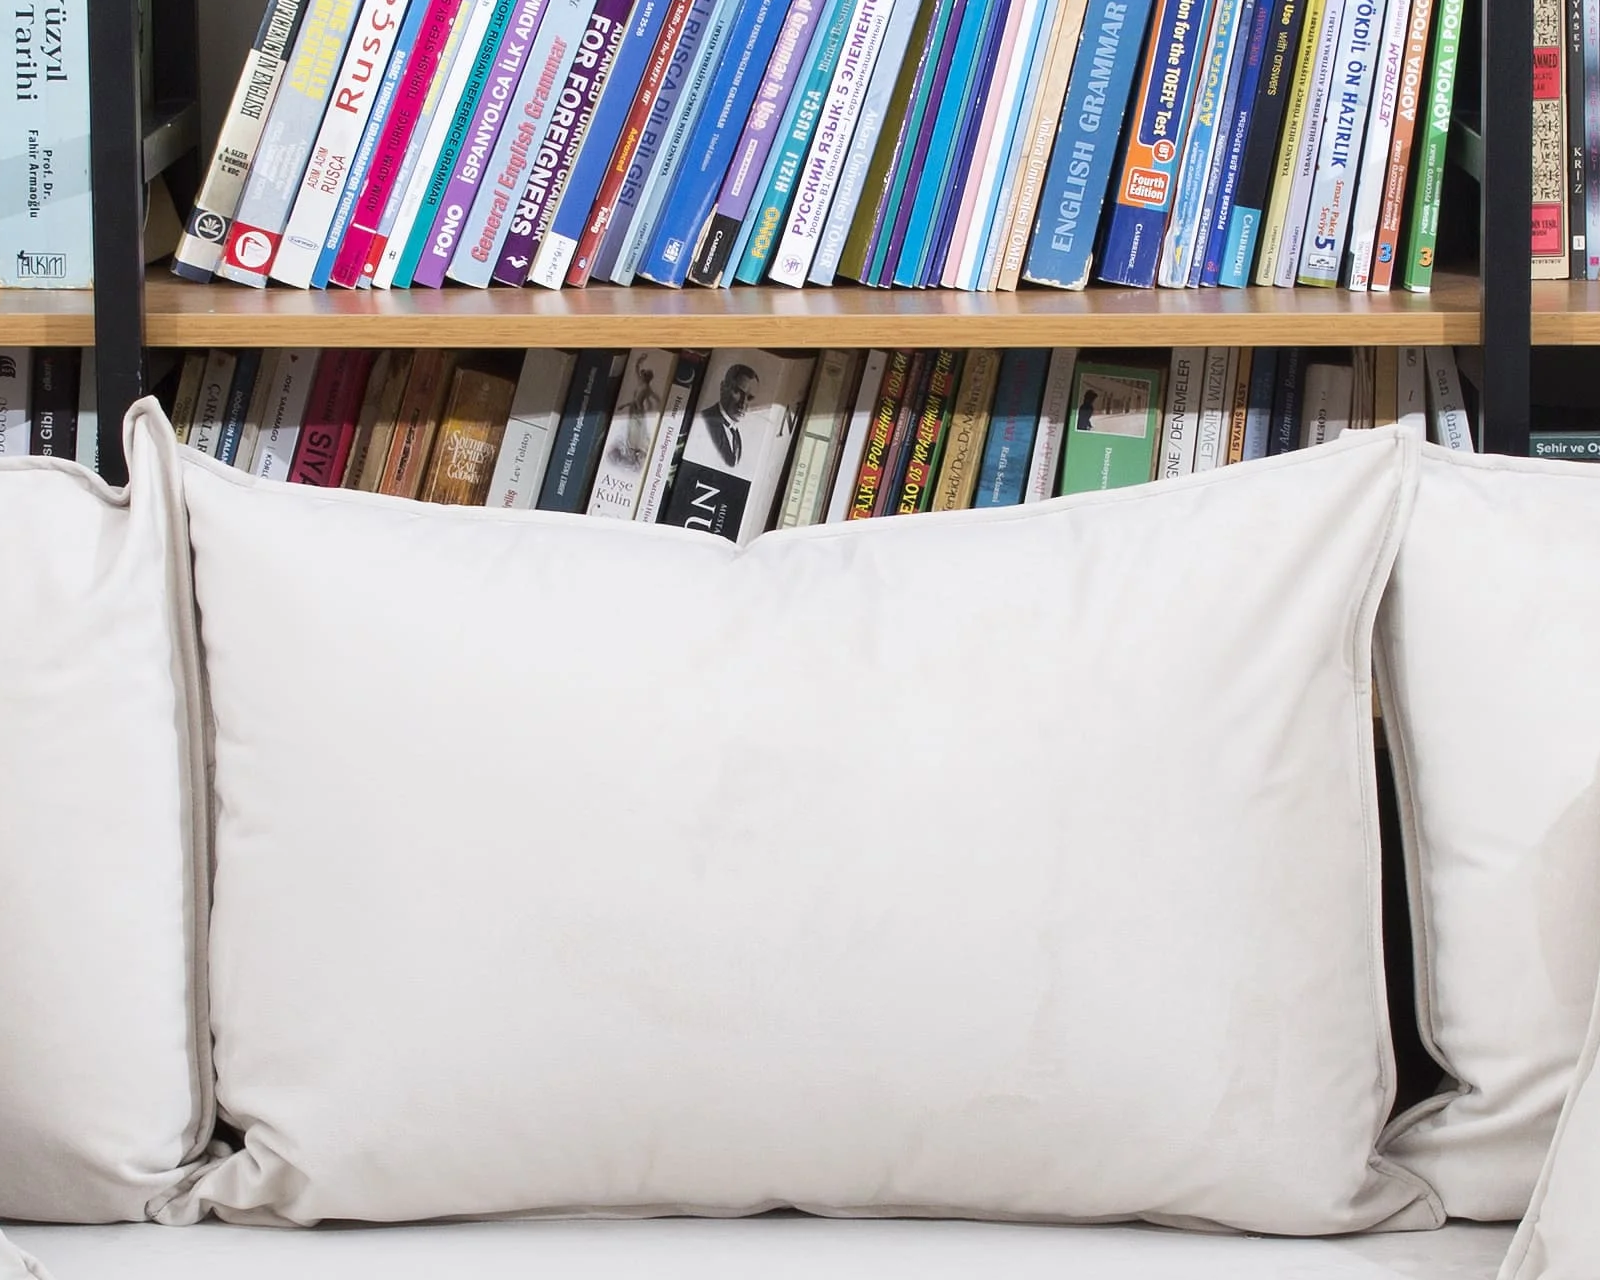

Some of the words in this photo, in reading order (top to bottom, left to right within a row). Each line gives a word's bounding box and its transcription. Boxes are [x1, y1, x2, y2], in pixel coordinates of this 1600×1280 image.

[14, 10, 40, 101] Tarihi
[573, 14, 609, 72] FOR
[241, 71, 275, 120] ENGLISH
[28, 130, 39, 159] Fahir
[510, 74, 590, 236] FOREIGNERS
[1329, 91, 1361, 169] HAZIRLIK
[27, 163, 41, 218] Armaoğlu
[1536, 443, 1569, 454] Şehir
[1573, 444, 1586, 453] ve
